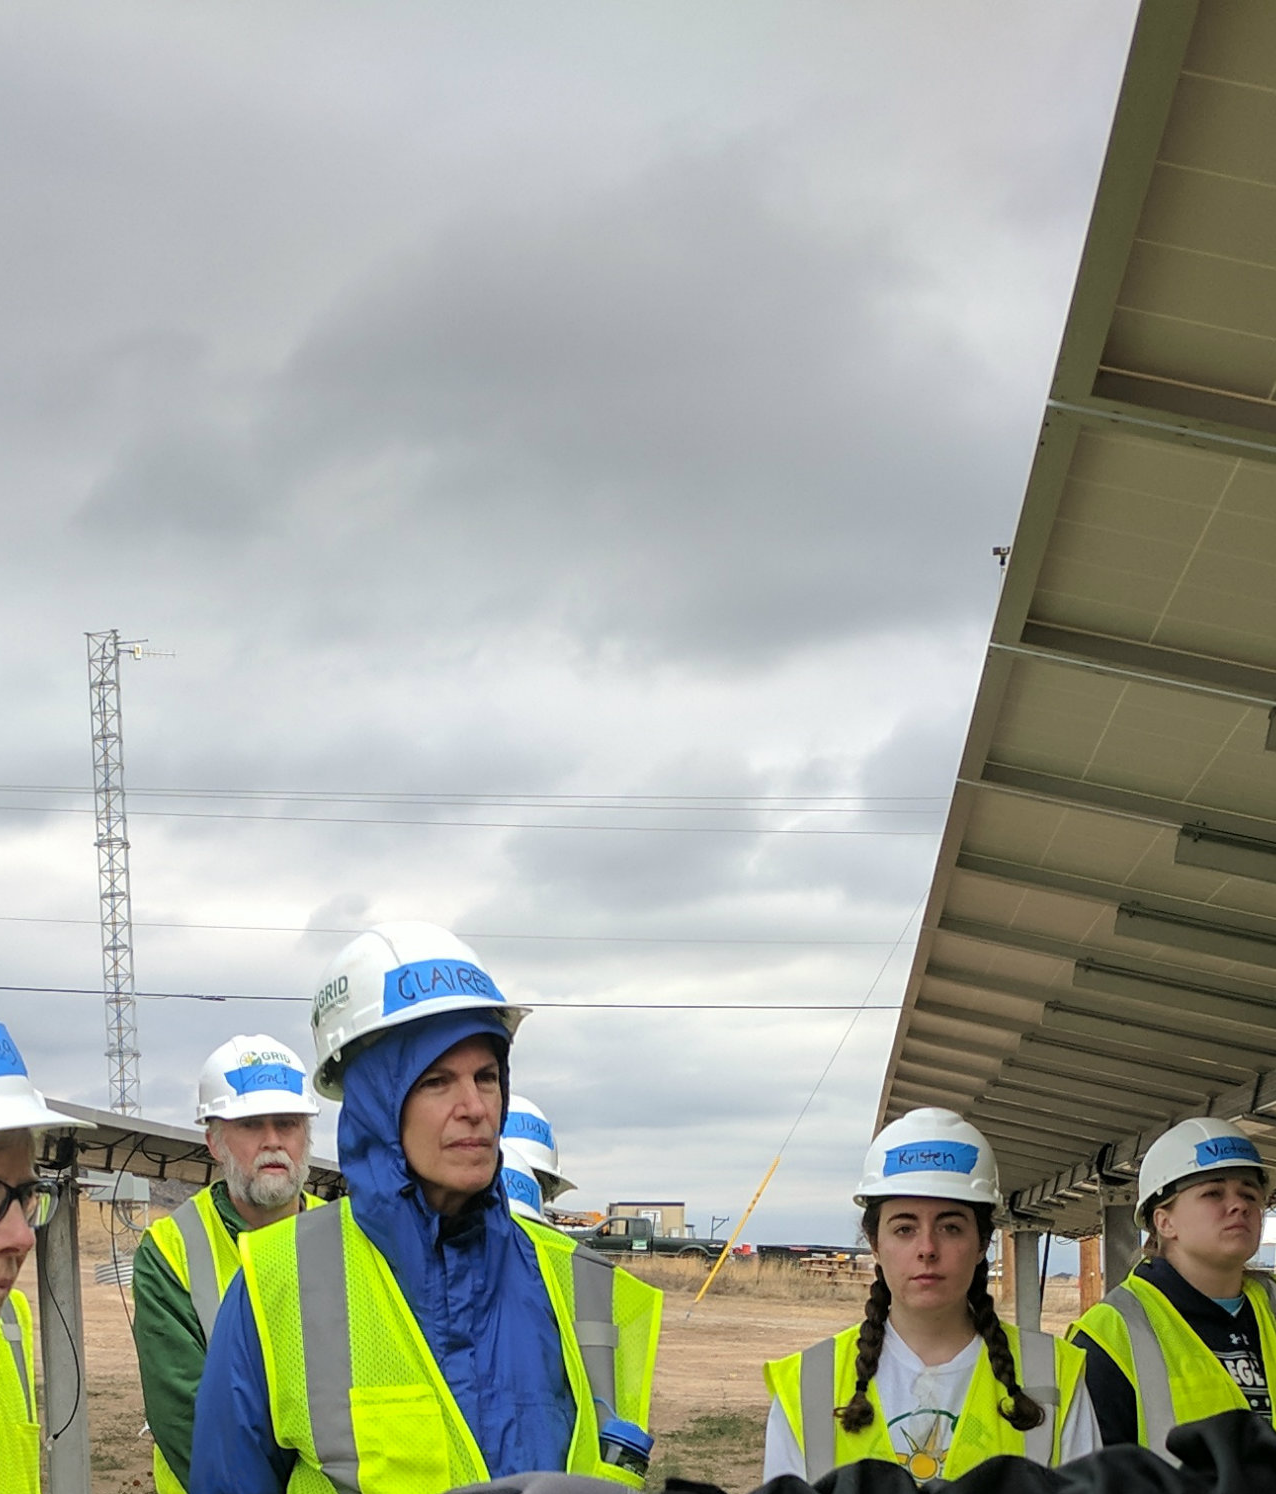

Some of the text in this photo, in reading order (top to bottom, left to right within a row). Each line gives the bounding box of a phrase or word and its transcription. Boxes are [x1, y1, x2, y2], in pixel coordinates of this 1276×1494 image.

[318, 975, 349, 1009] GRID
[397, 966, 489, 1001] CLAIRE
[261, 1051, 292, 1065] GRID
[514, 1115, 550, 1141] Judy
[898, 1150, 956, 1168] Kristen
[505, 1172, 534, 1205] Kay
